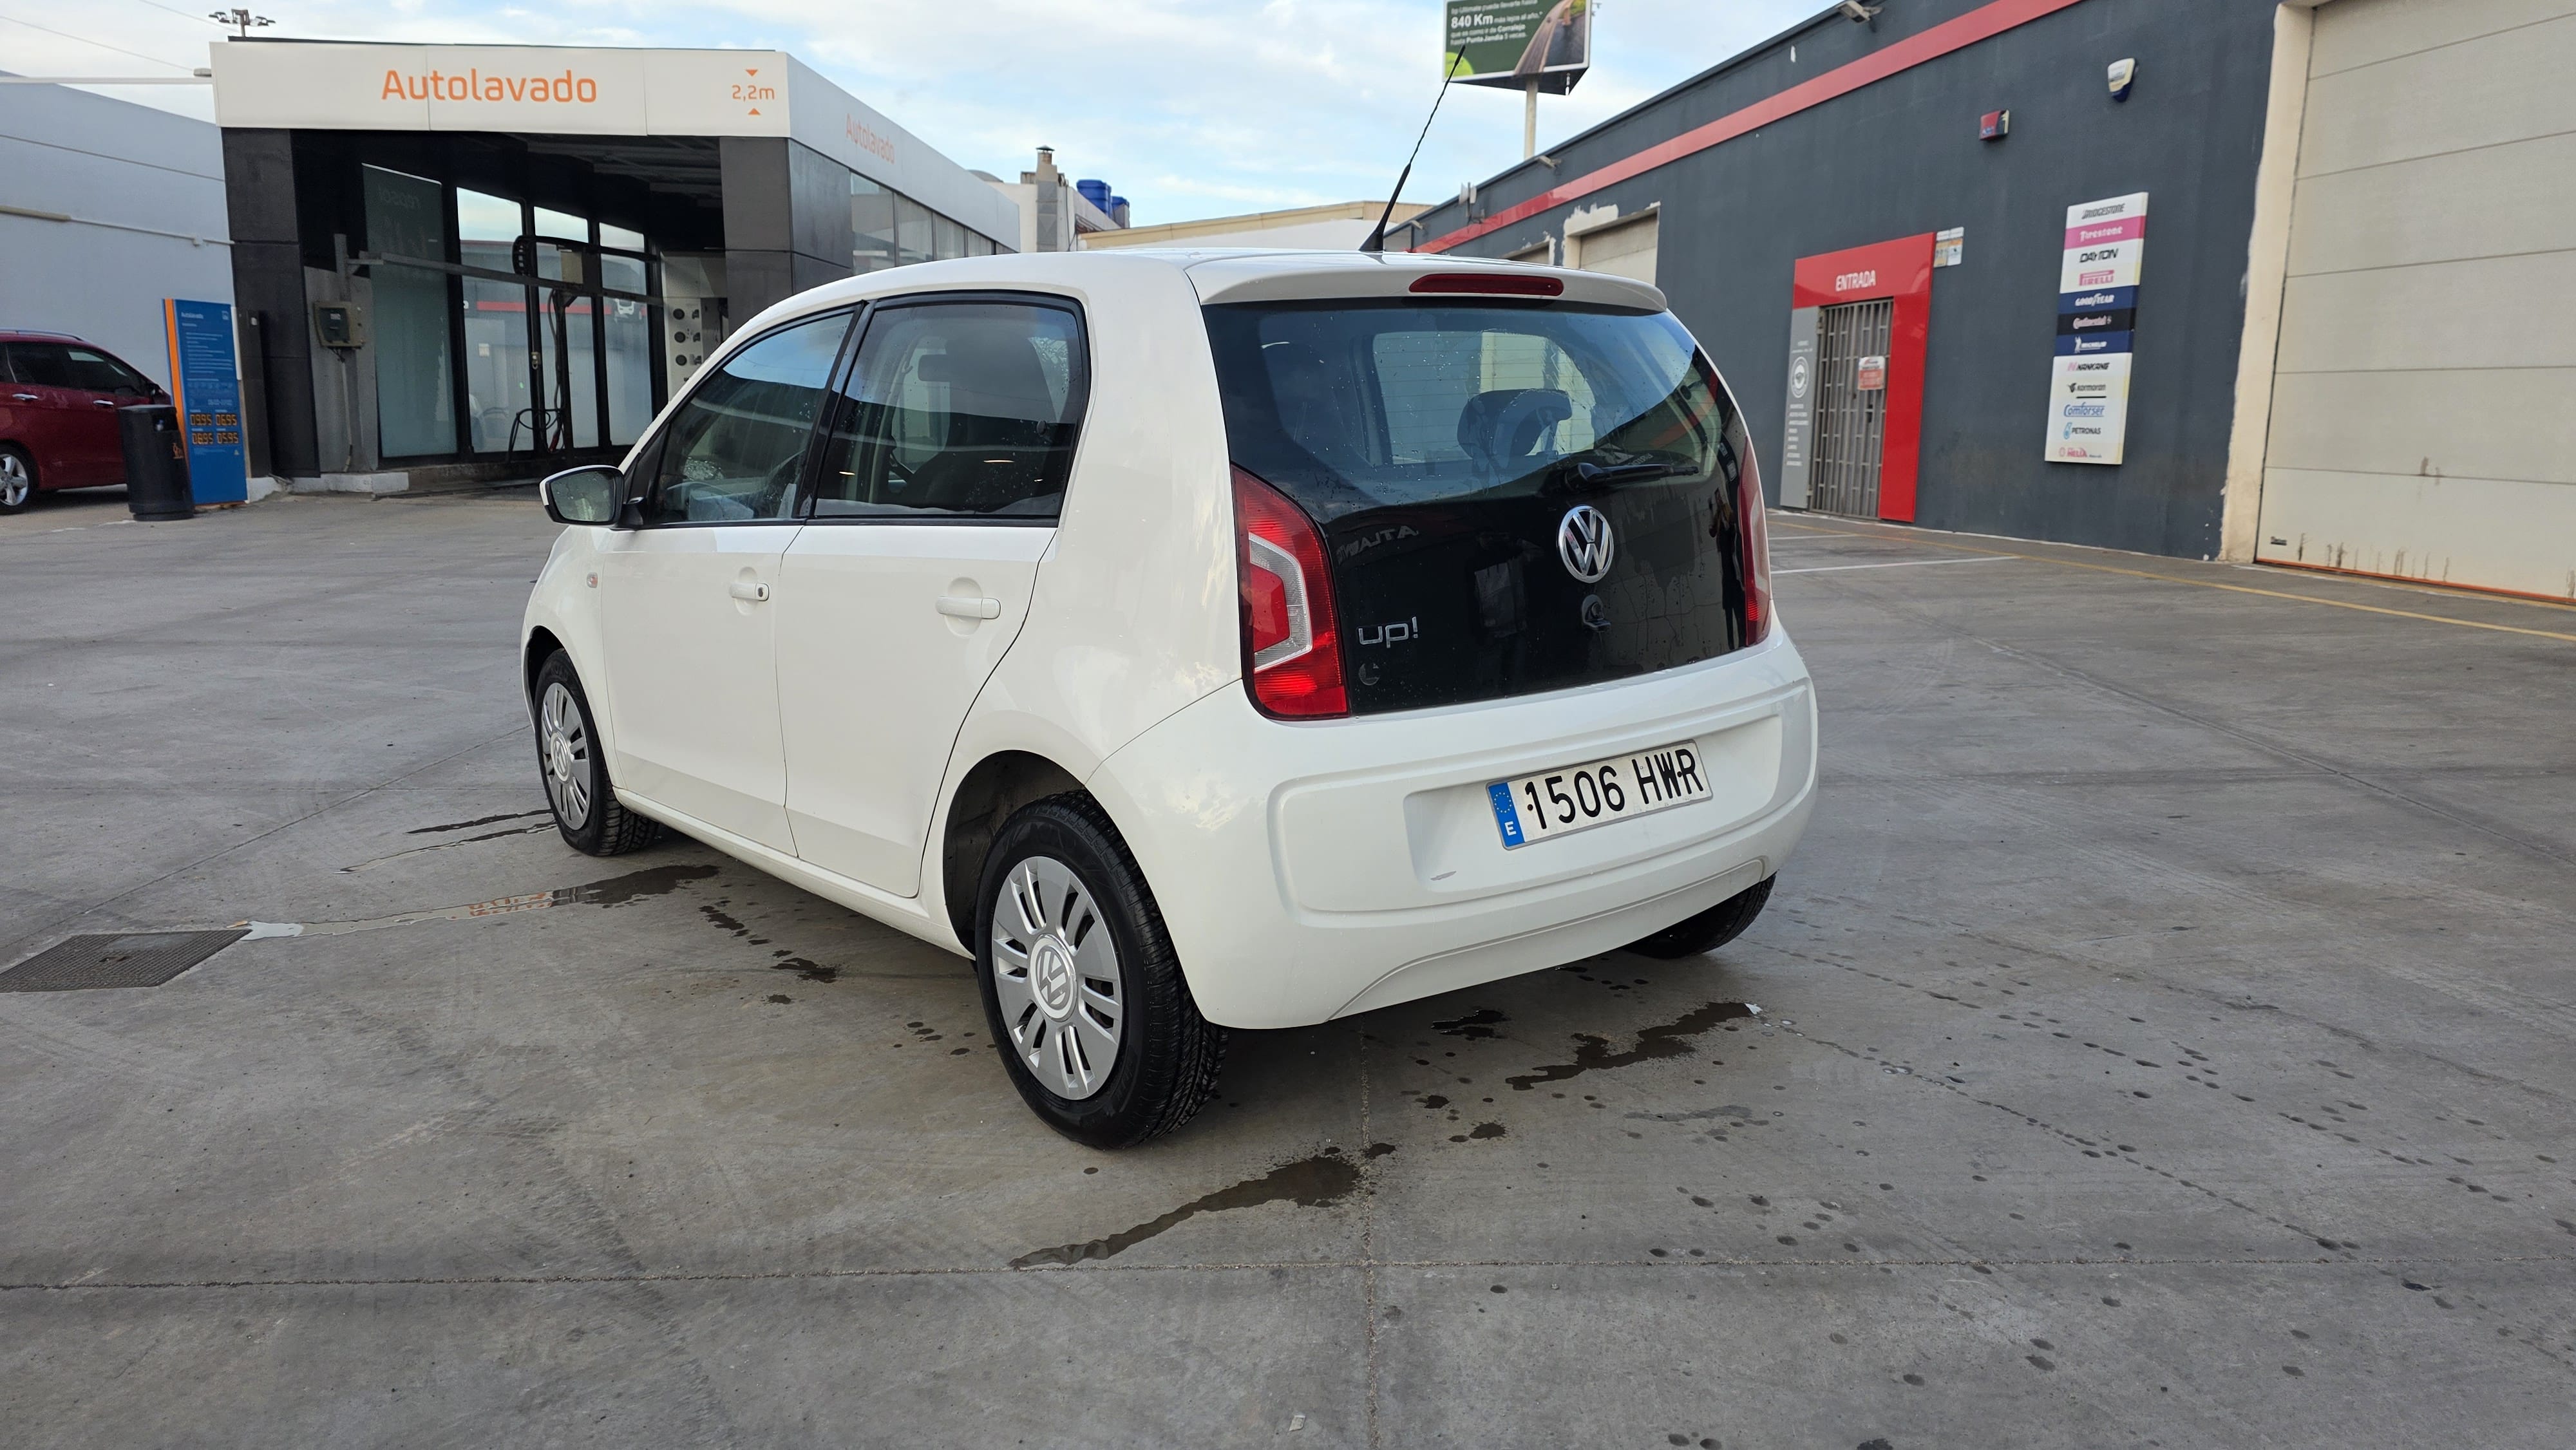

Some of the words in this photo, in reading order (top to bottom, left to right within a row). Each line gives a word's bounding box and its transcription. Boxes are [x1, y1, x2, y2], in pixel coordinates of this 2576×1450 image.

[1450, 15, 1472, 29] 840
[1473, 14, 1493, 26] Km
[381, 68, 597, 102] Autolavado
[732, 84, 775, 102] 2,2m
[846, 113, 895, 165] Autolavado
[2079, 248, 2119, 263] DAYTON
[1835, 270, 1876, 292] ENTRADA
[2079, 269, 2115, 286] PIRELLI
[1358, 616, 1418, 648] up!
[1524, 766, 1625, 829] 1506
[1631, 748, 1704, 804] HWR
[1504, 821, 1517, 836] E
